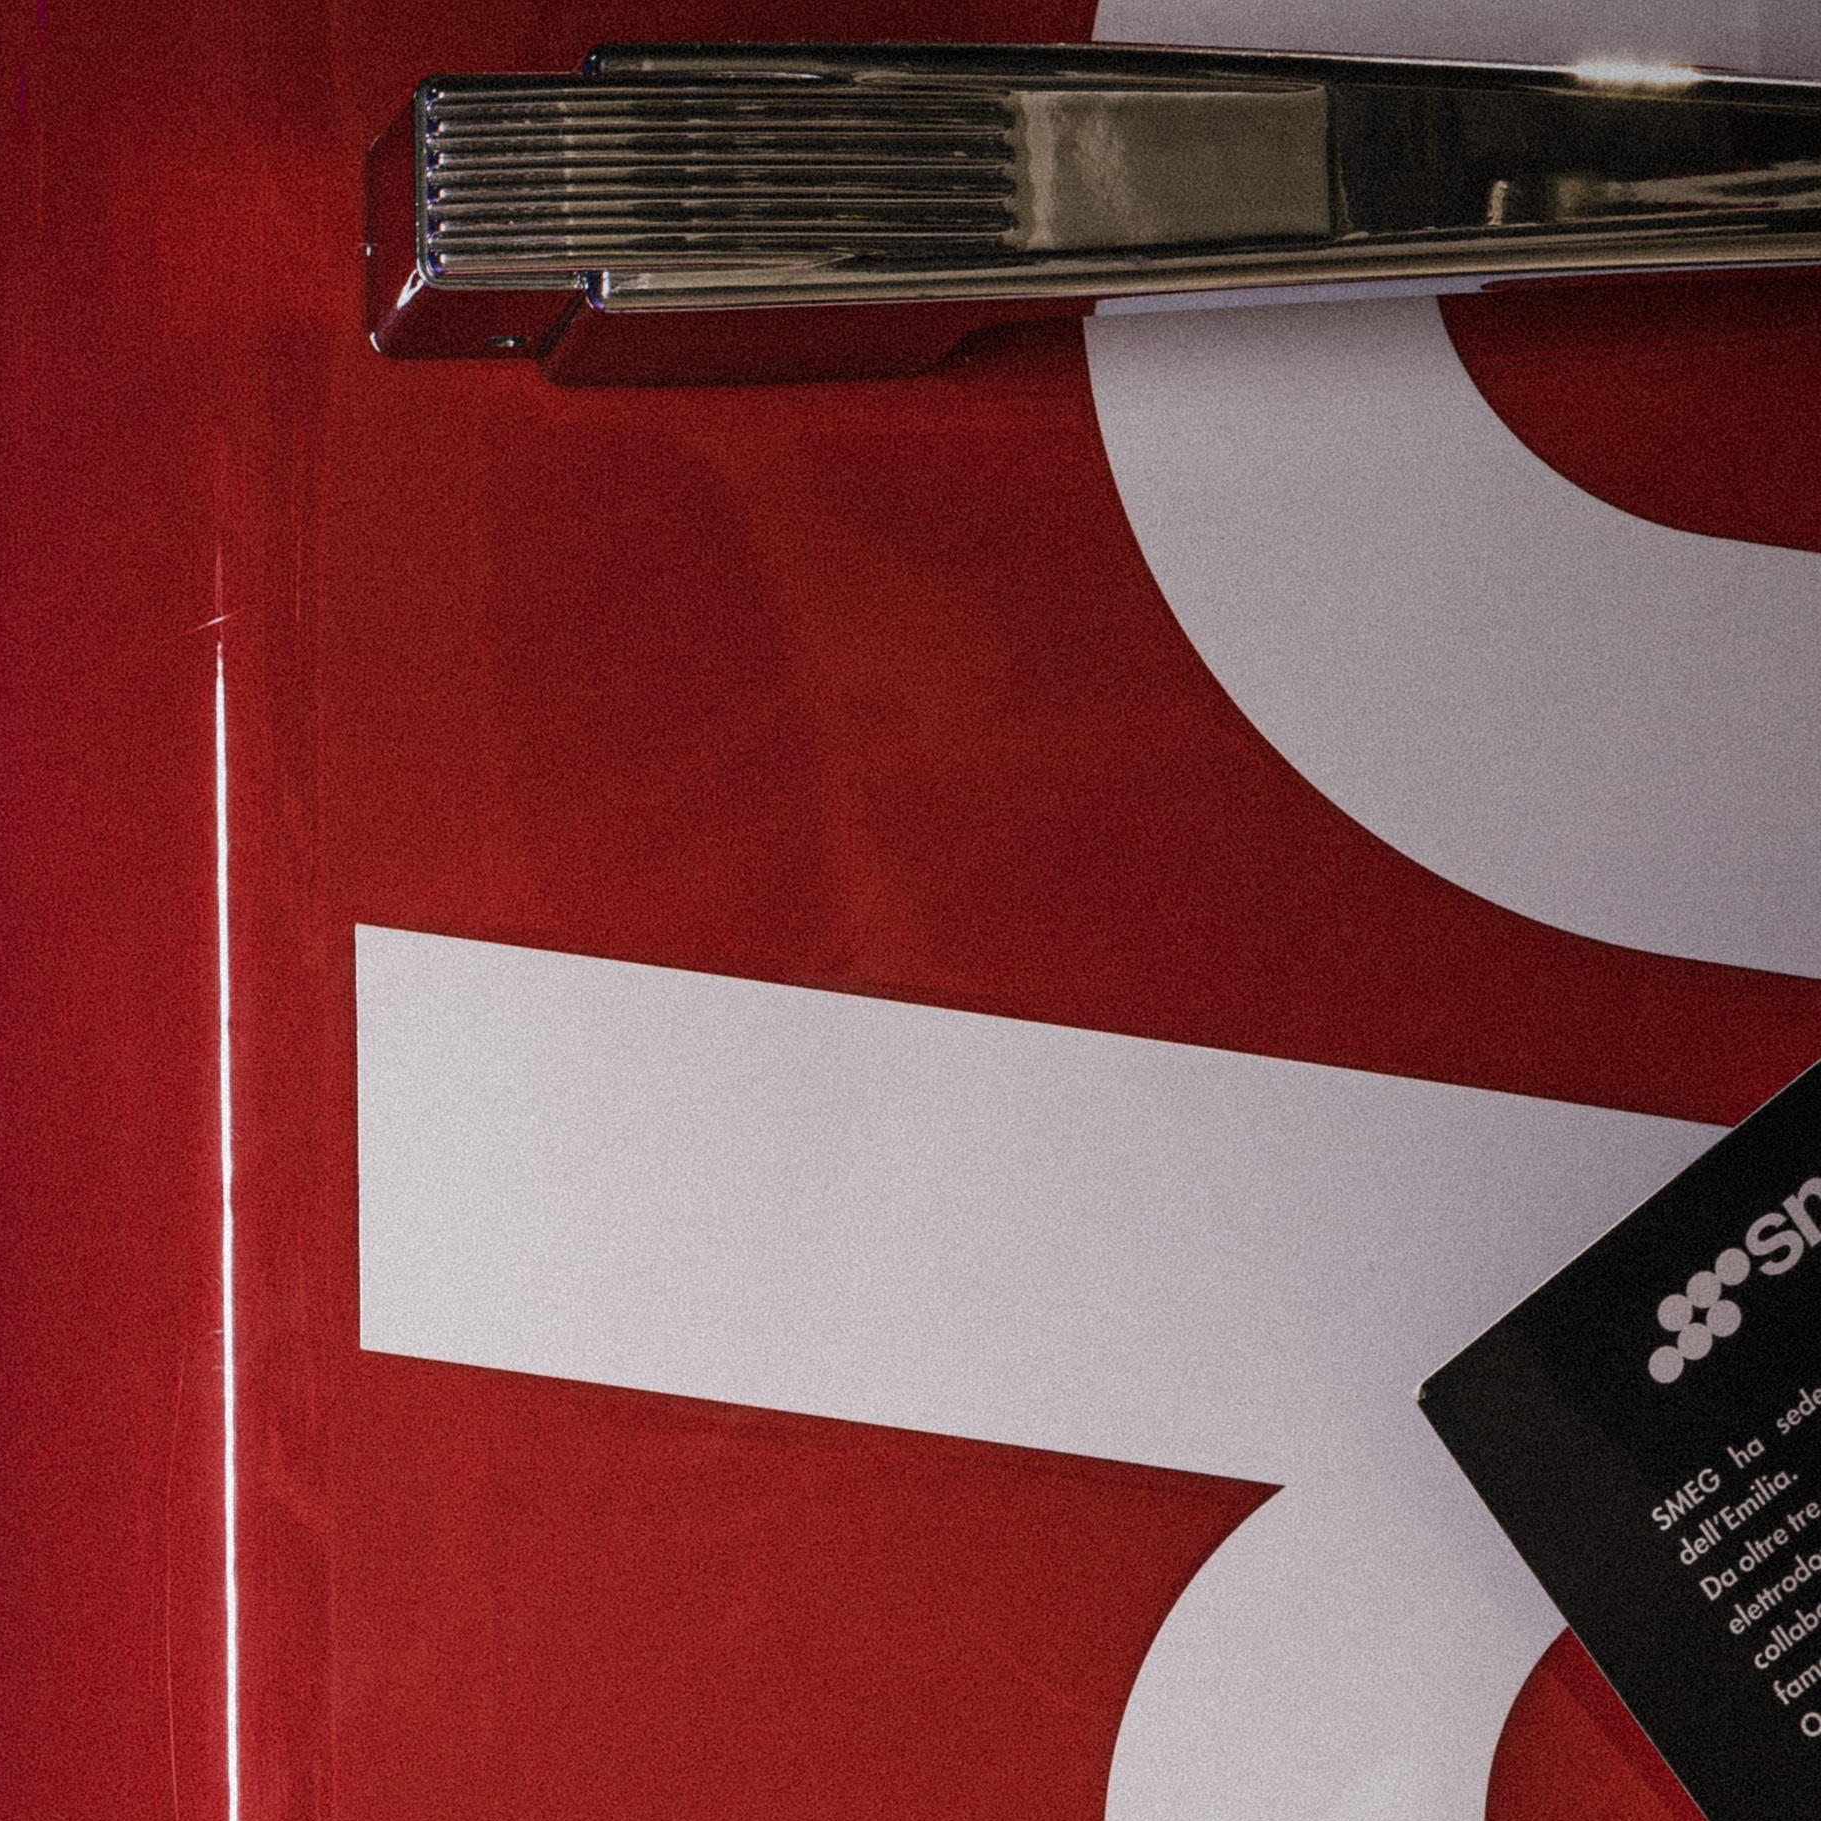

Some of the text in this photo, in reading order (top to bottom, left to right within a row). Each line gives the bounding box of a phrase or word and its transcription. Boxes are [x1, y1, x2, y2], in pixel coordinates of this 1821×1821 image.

[1651, 1468, 1721, 1531] SMEG
[1727, 1437, 1765, 1469] ha
[1680, 1471, 1799, 1565] dell'Emilia.
[1699, 1568, 1738, 1601] Da
[1739, 1528, 1789, 1572] oltre
[1773, 1659, 1821, 1705] fam
